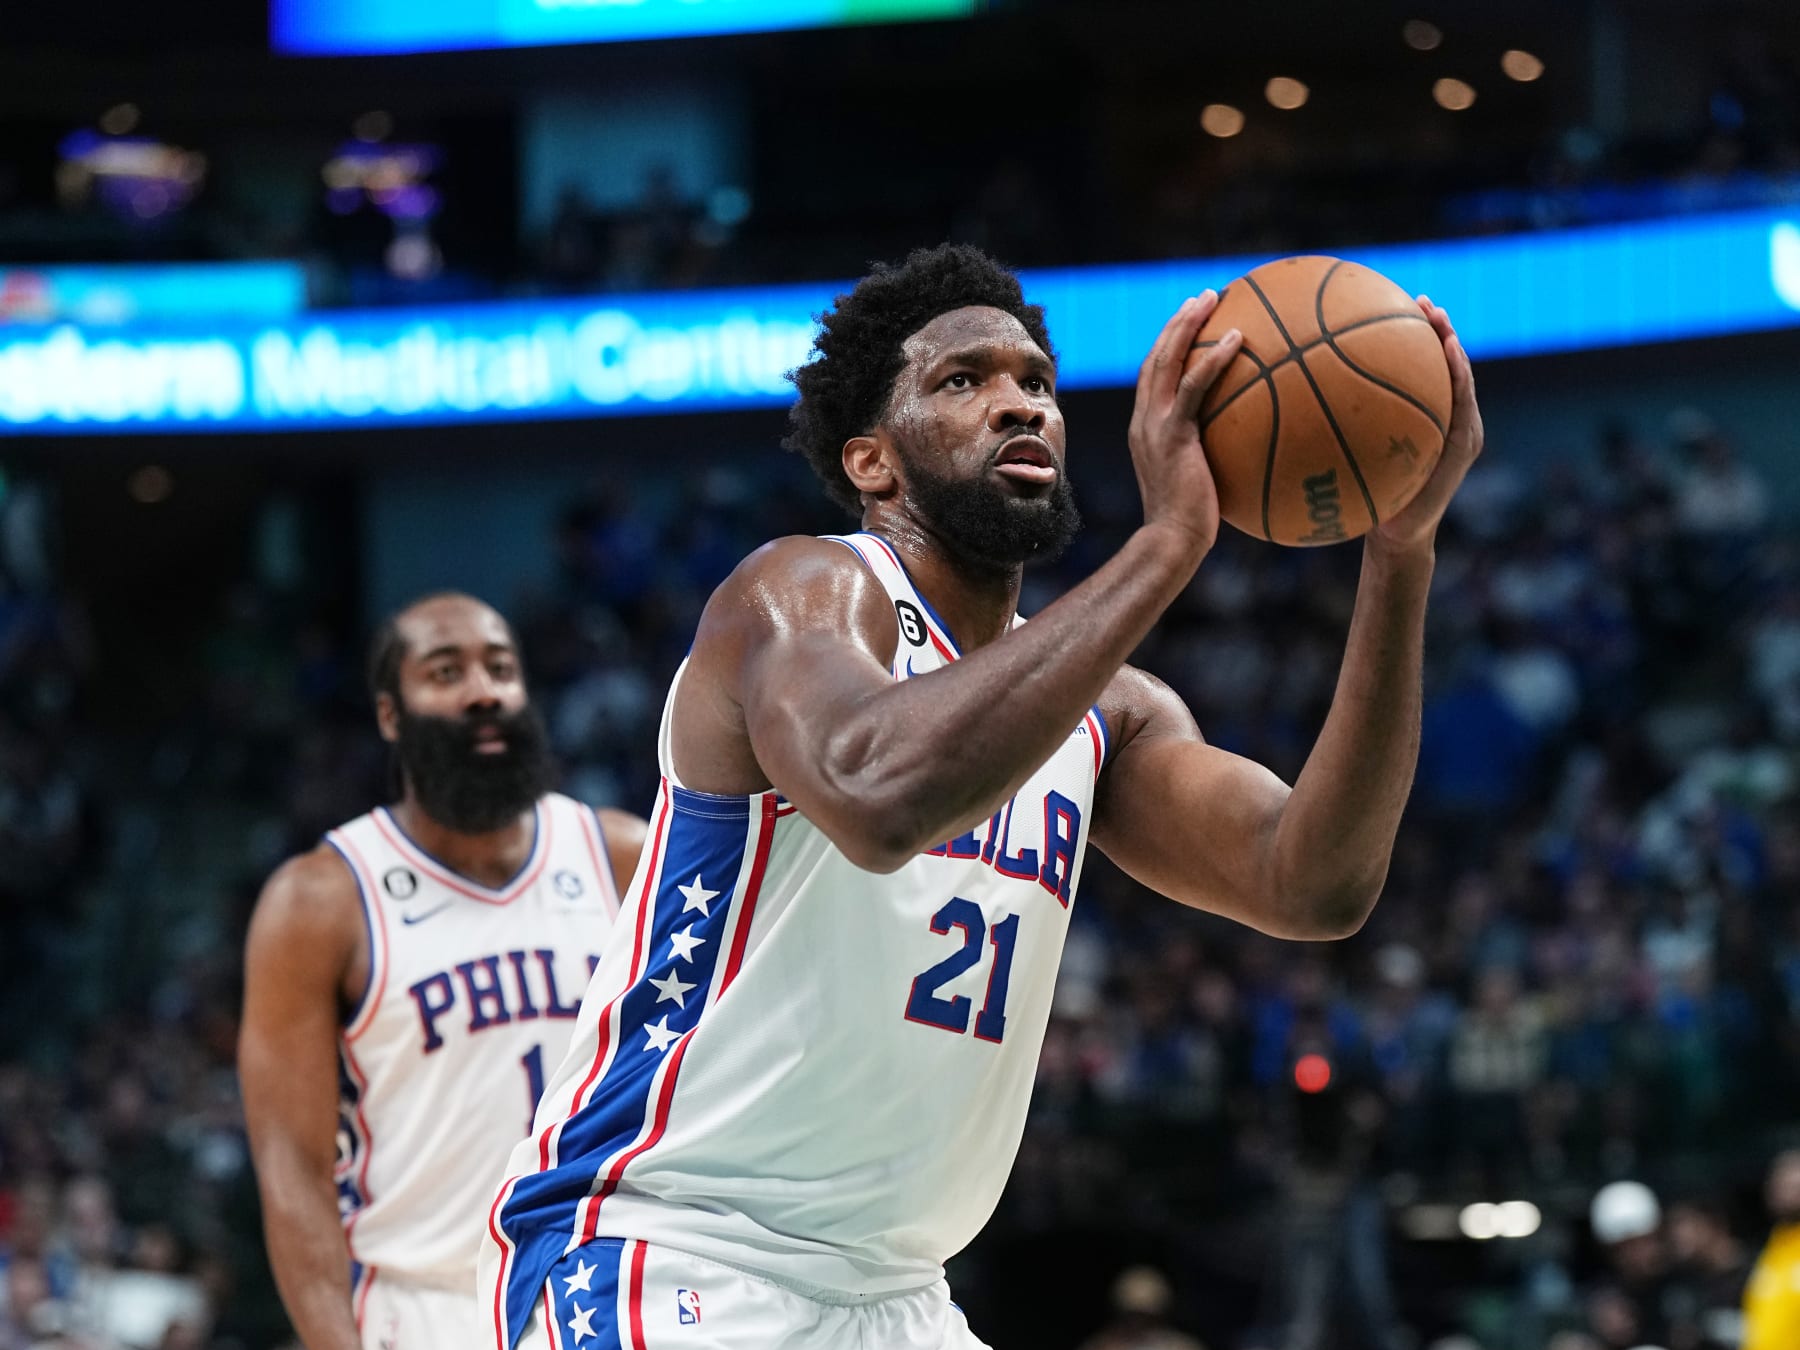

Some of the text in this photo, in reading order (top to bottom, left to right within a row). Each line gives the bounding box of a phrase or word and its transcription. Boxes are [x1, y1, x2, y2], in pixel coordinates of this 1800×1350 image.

[899, 606, 921, 642] 6
[409, 948, 600, 1055] PHIL
[904, 896, 1020, 1045] 21
